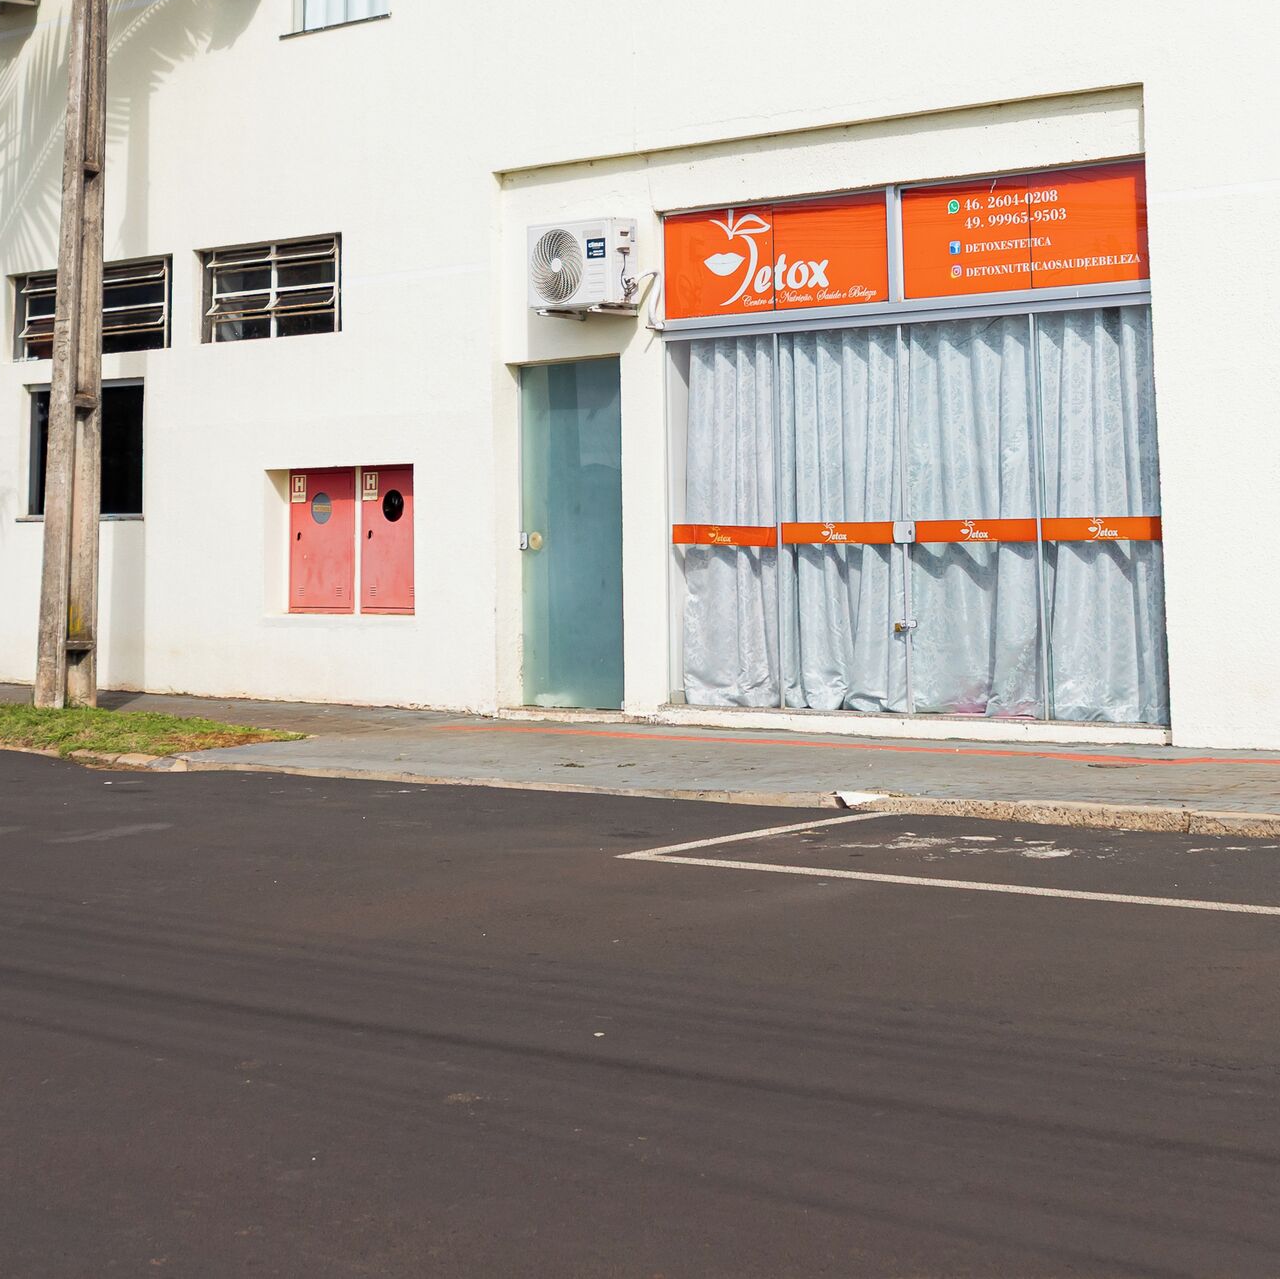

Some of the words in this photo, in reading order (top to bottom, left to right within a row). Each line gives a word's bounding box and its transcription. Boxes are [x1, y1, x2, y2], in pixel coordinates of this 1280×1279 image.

[988, 190, 1058, 208] 2604-0208
[988, 208, 1067, 226] 99965-9503
[965, 236, 1052, 254] DETOXESTETICA
[294, 477, 304, 492] H
[366, 474, 376, 490] H
